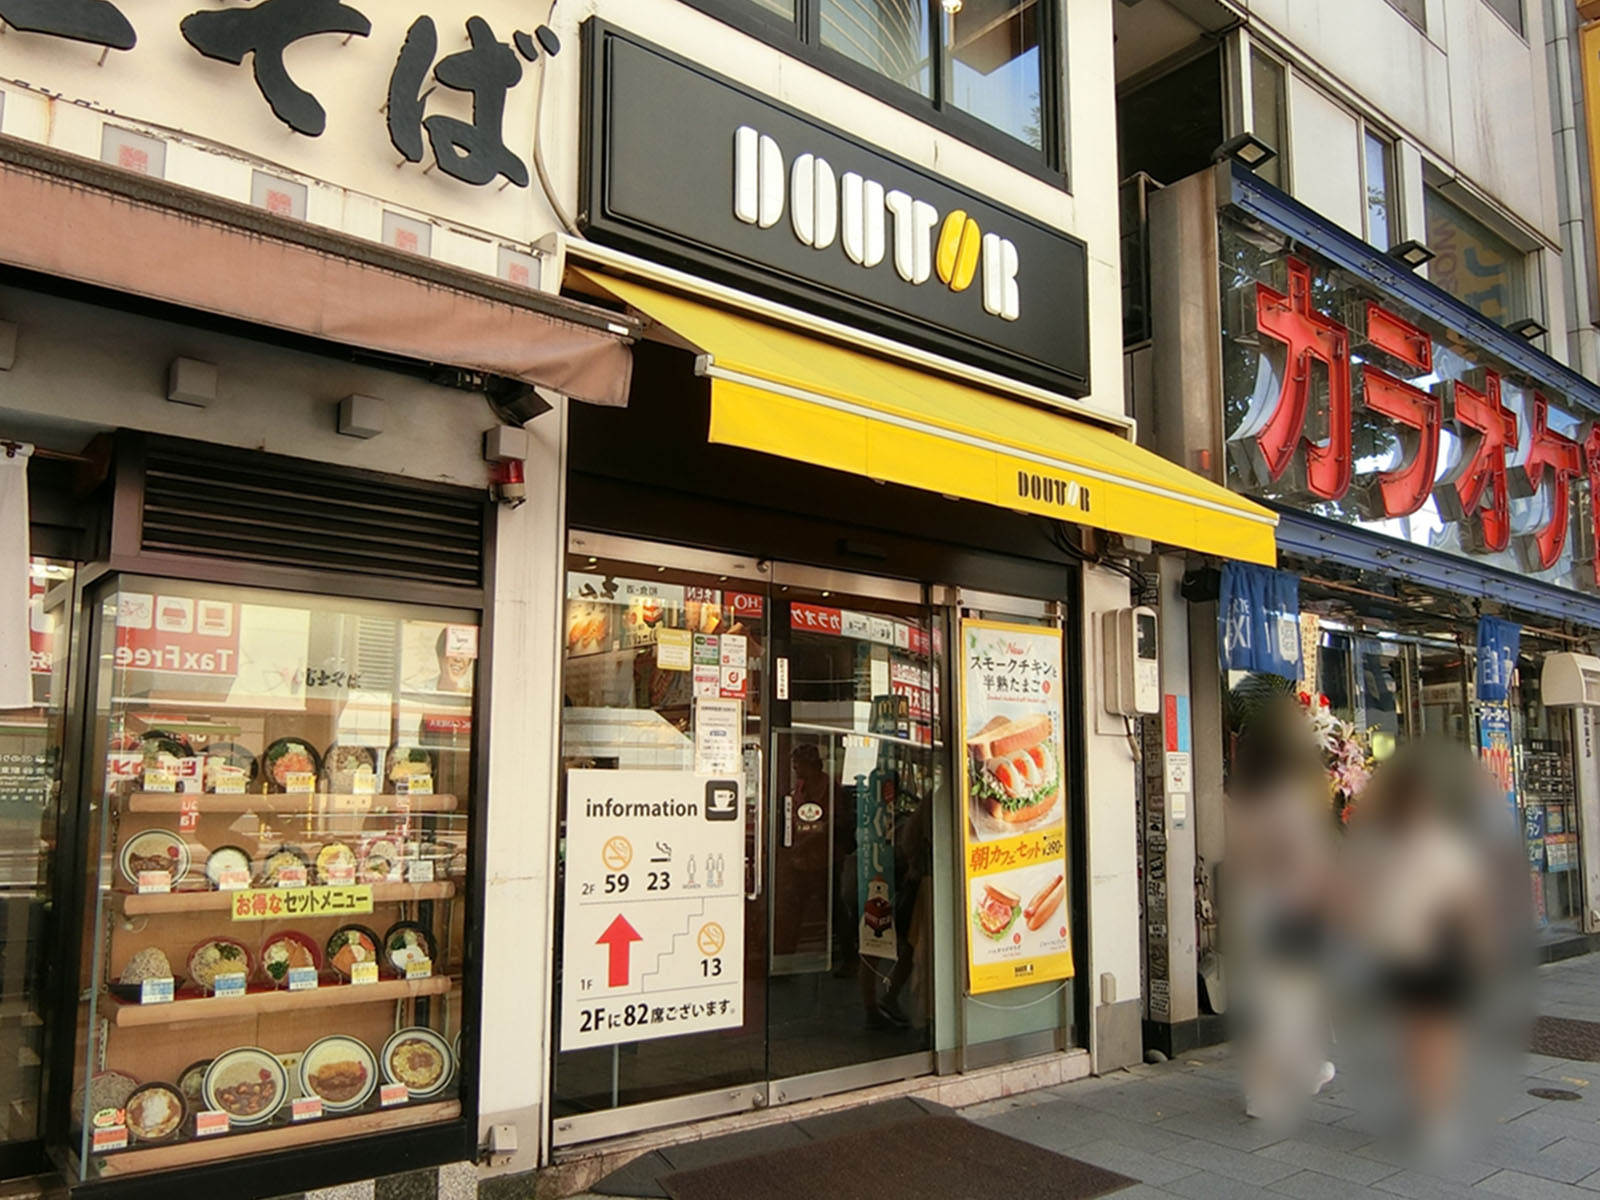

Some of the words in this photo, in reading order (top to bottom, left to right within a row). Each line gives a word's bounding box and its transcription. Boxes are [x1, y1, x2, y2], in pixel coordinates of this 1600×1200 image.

[0, 0, 560, 187] そば
[733, 125, 1020, 321] DOUTOR
[1256, 256, 1600, 588] カラオケ
[1018, 471, 1090, 512] DOUTOR
[970, 656, 1057, 678] スモークチキンと
[982, 674, 1041, 693] 半熟たまご
[585, 798, 698, 817] information
[969, 842, 1042, 871] 朝カフェセット
[582, 883, 595, 895] 2F
[604, 874, 630, 894] 59
[647, 872, 671, 891] 23
[235, 890, 369, 916] お得なセットメニュー
[700, 958, 722, 977] 13
[580, 979, 593, 991] 1F
[580, 999, 736, 1033] 2Fに82席ございます。
